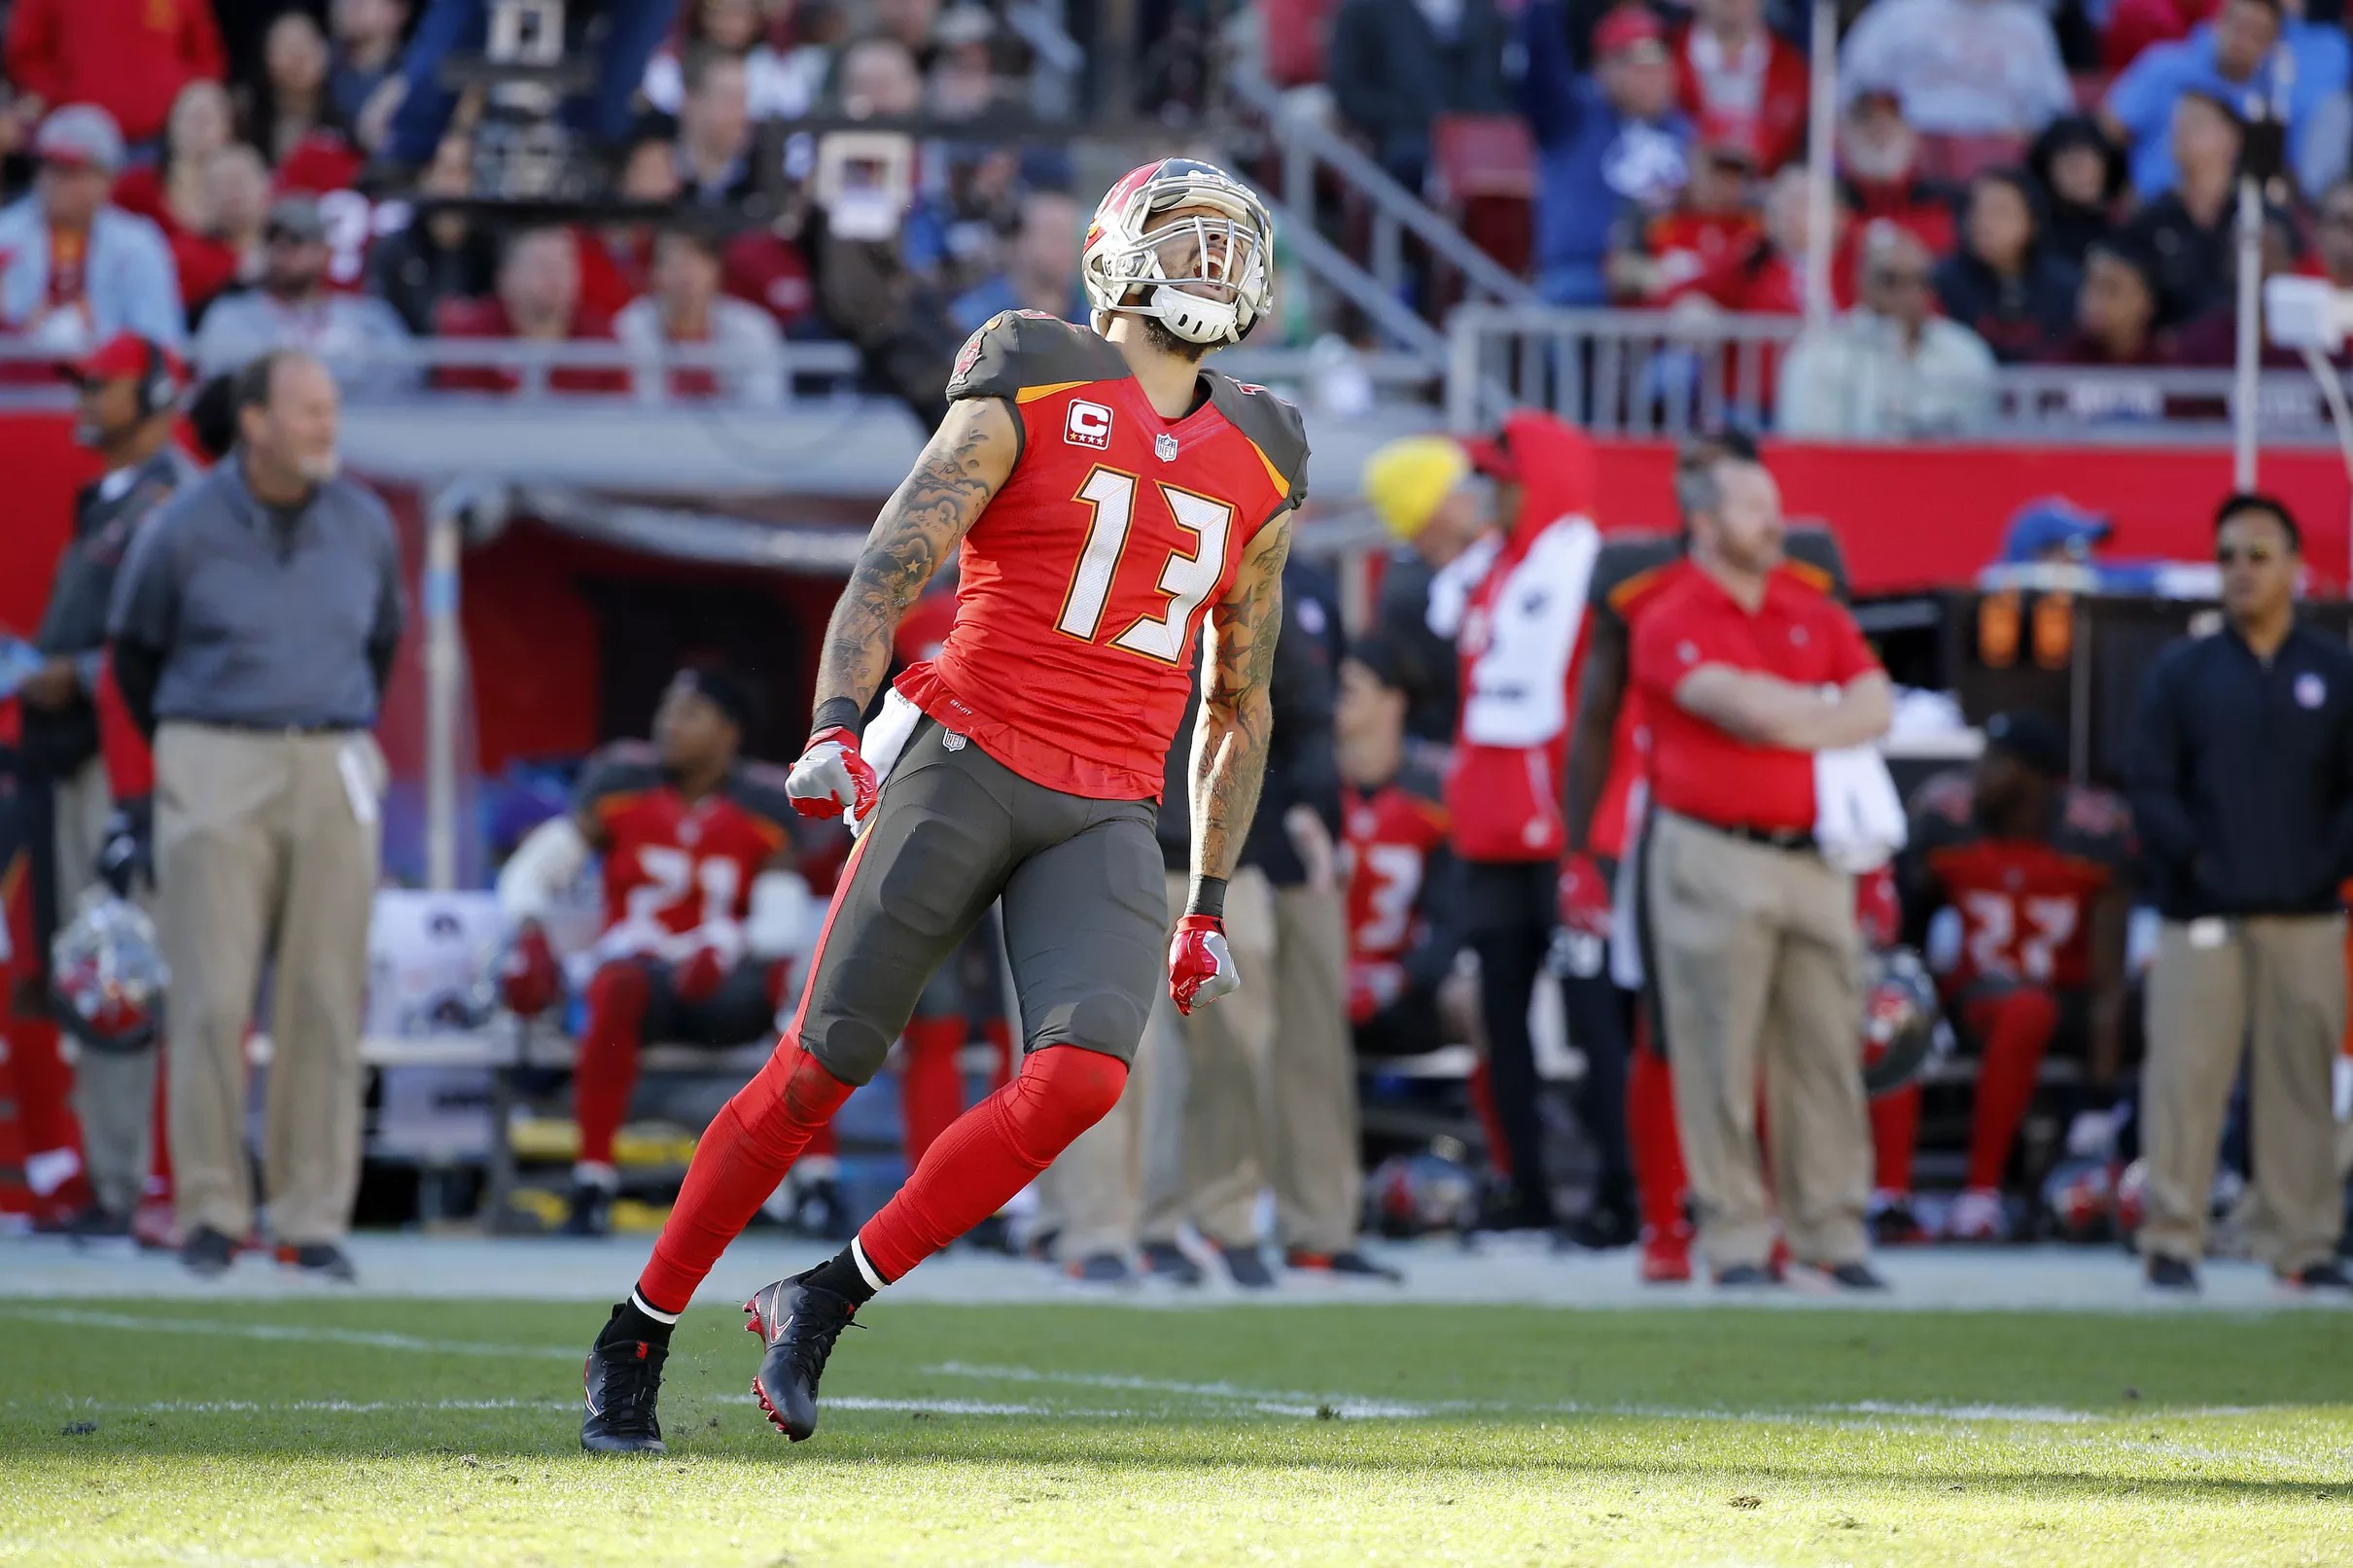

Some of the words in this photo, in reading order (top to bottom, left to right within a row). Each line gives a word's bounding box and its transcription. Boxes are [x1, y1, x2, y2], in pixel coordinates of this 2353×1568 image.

[1070, 403, 1108, 437] C
[1052, 462, 1235, 668] 13
[626, 844, 740, 939] 21
[1962, 889, 2078, 981] 27
